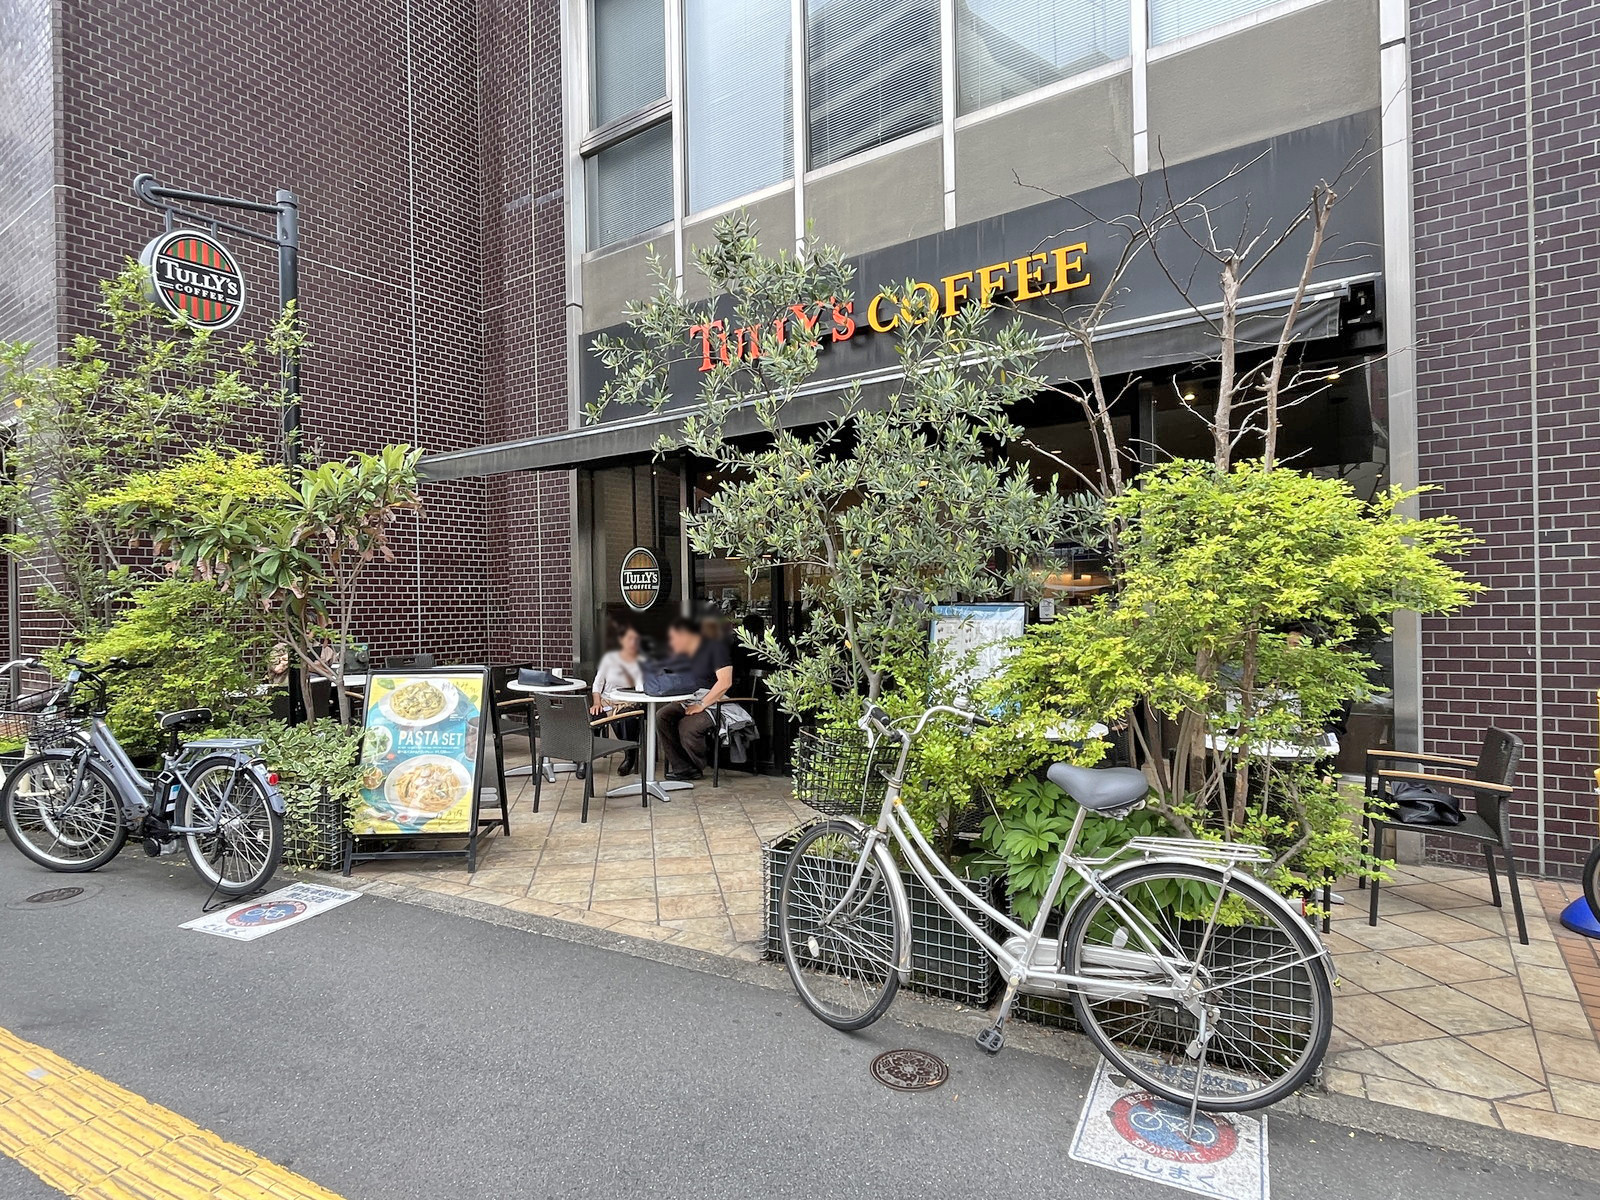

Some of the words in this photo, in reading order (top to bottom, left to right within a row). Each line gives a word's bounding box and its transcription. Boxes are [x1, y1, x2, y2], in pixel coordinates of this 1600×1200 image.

[160, 258, 239, 296] TULLY'S
[866, 241, 1092, 334] COFFEE
[174, 283, 225, 302] COFFEE
[623, 571, 658, 584] TULLY'S
[397, 730, 440, 746] PASTA
[441, 732, 464, 746] SET
[1131, 1137, 1207, 1161] おかないで
[1116, 1152, 1216, 1190] としまく
